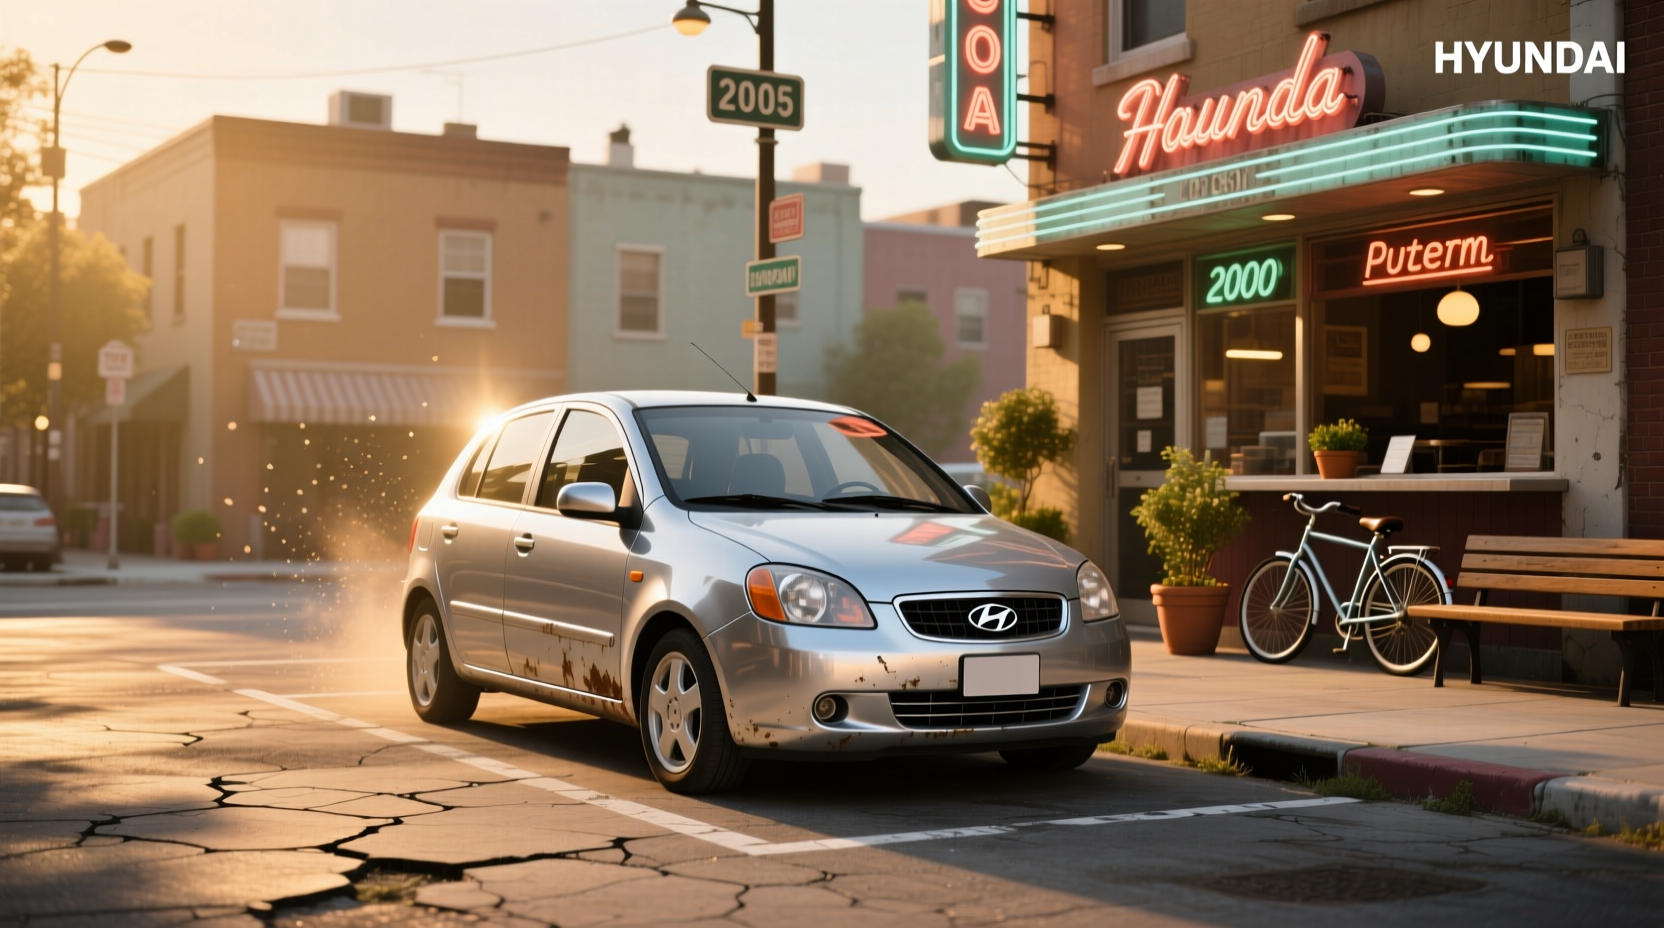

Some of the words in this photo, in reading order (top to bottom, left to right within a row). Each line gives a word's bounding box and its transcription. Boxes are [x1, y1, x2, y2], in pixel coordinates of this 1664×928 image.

[964, 0, 1001, 135] OA
[718, 77, 794, 118] 2005
[1364, 235, 1494, 279] Puterm
[1206, 258, 1279, 303] 2000
